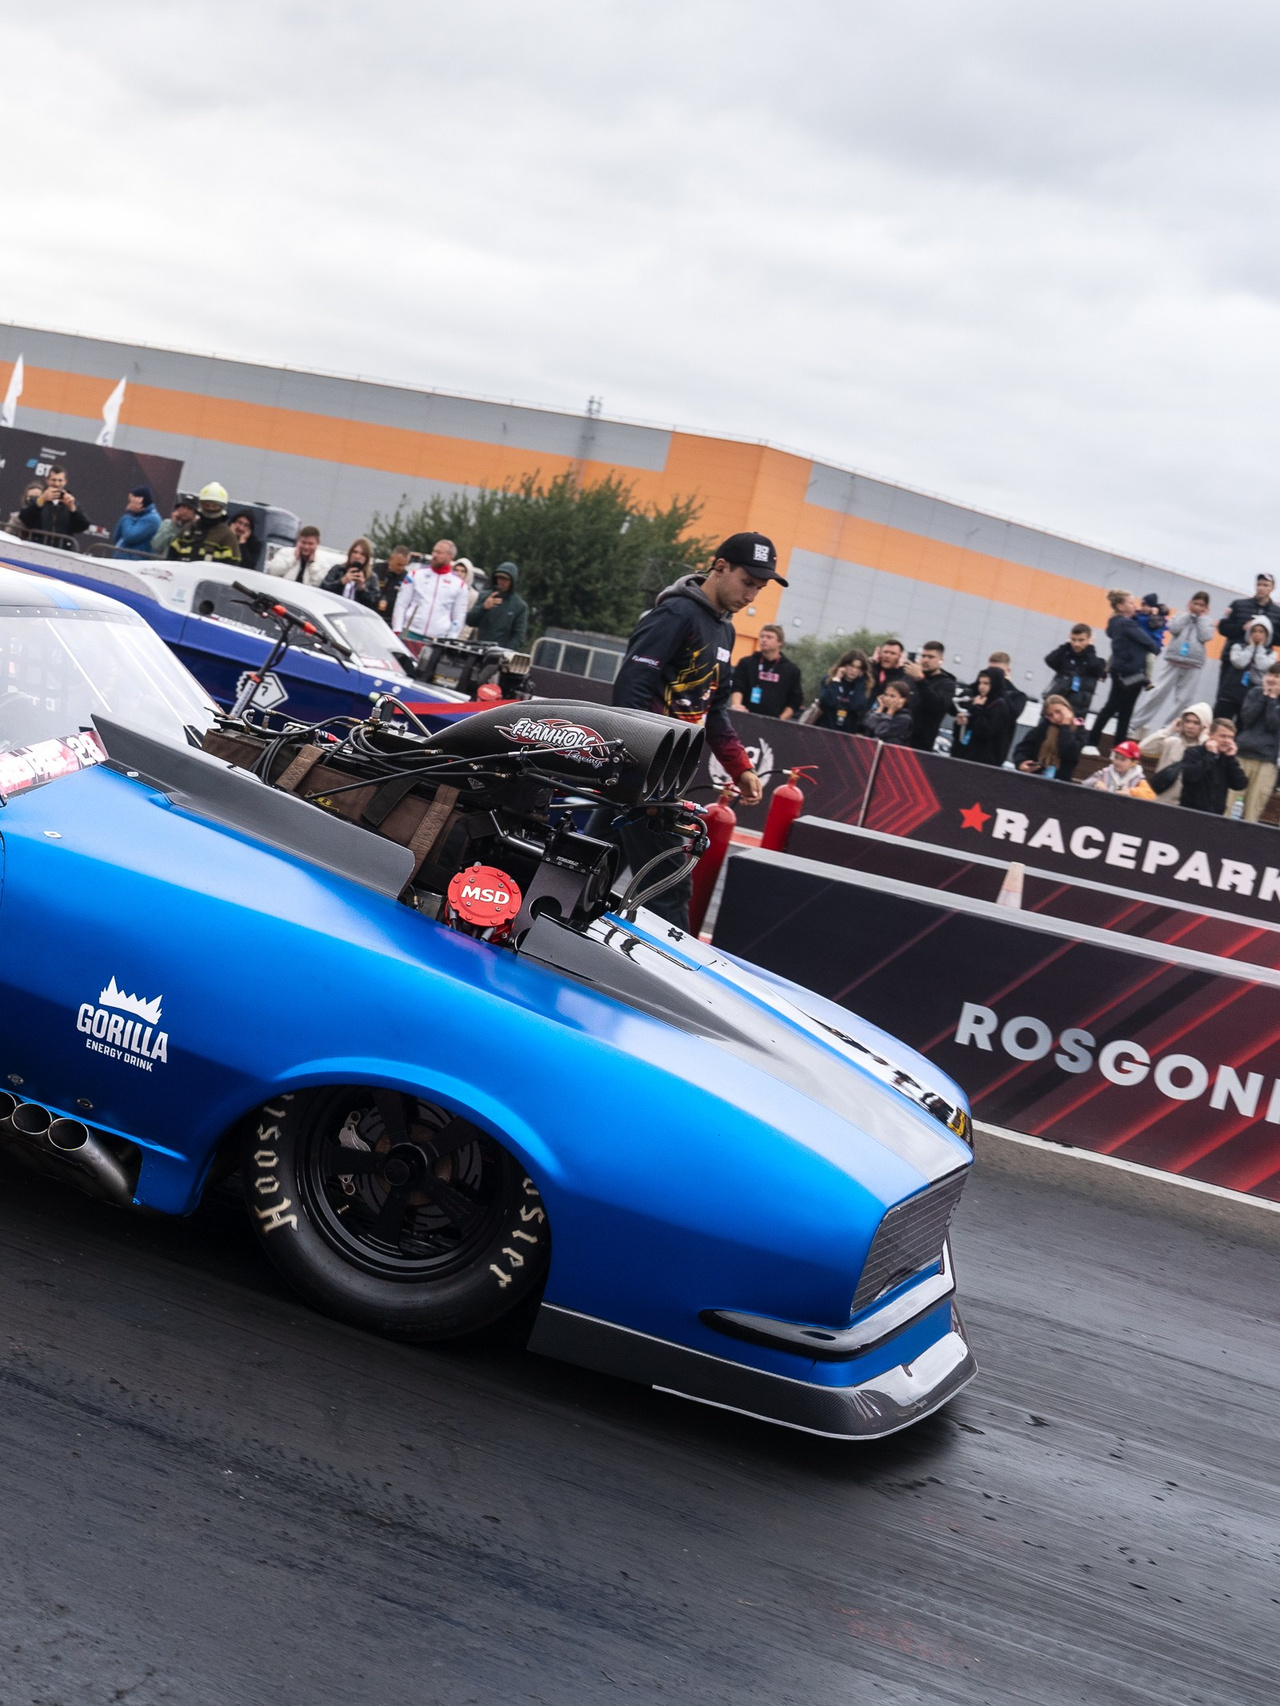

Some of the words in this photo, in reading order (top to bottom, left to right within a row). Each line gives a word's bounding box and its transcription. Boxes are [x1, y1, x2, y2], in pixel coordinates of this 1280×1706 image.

[66, 734, 106, 766] 28
[461, 885, 510, 905] MSD
[76, 1003, 169, 1063] GORILLA
[86, 1038, 123, 1060] ENERGY
[124, 1052, 154, 1072] DRINK
